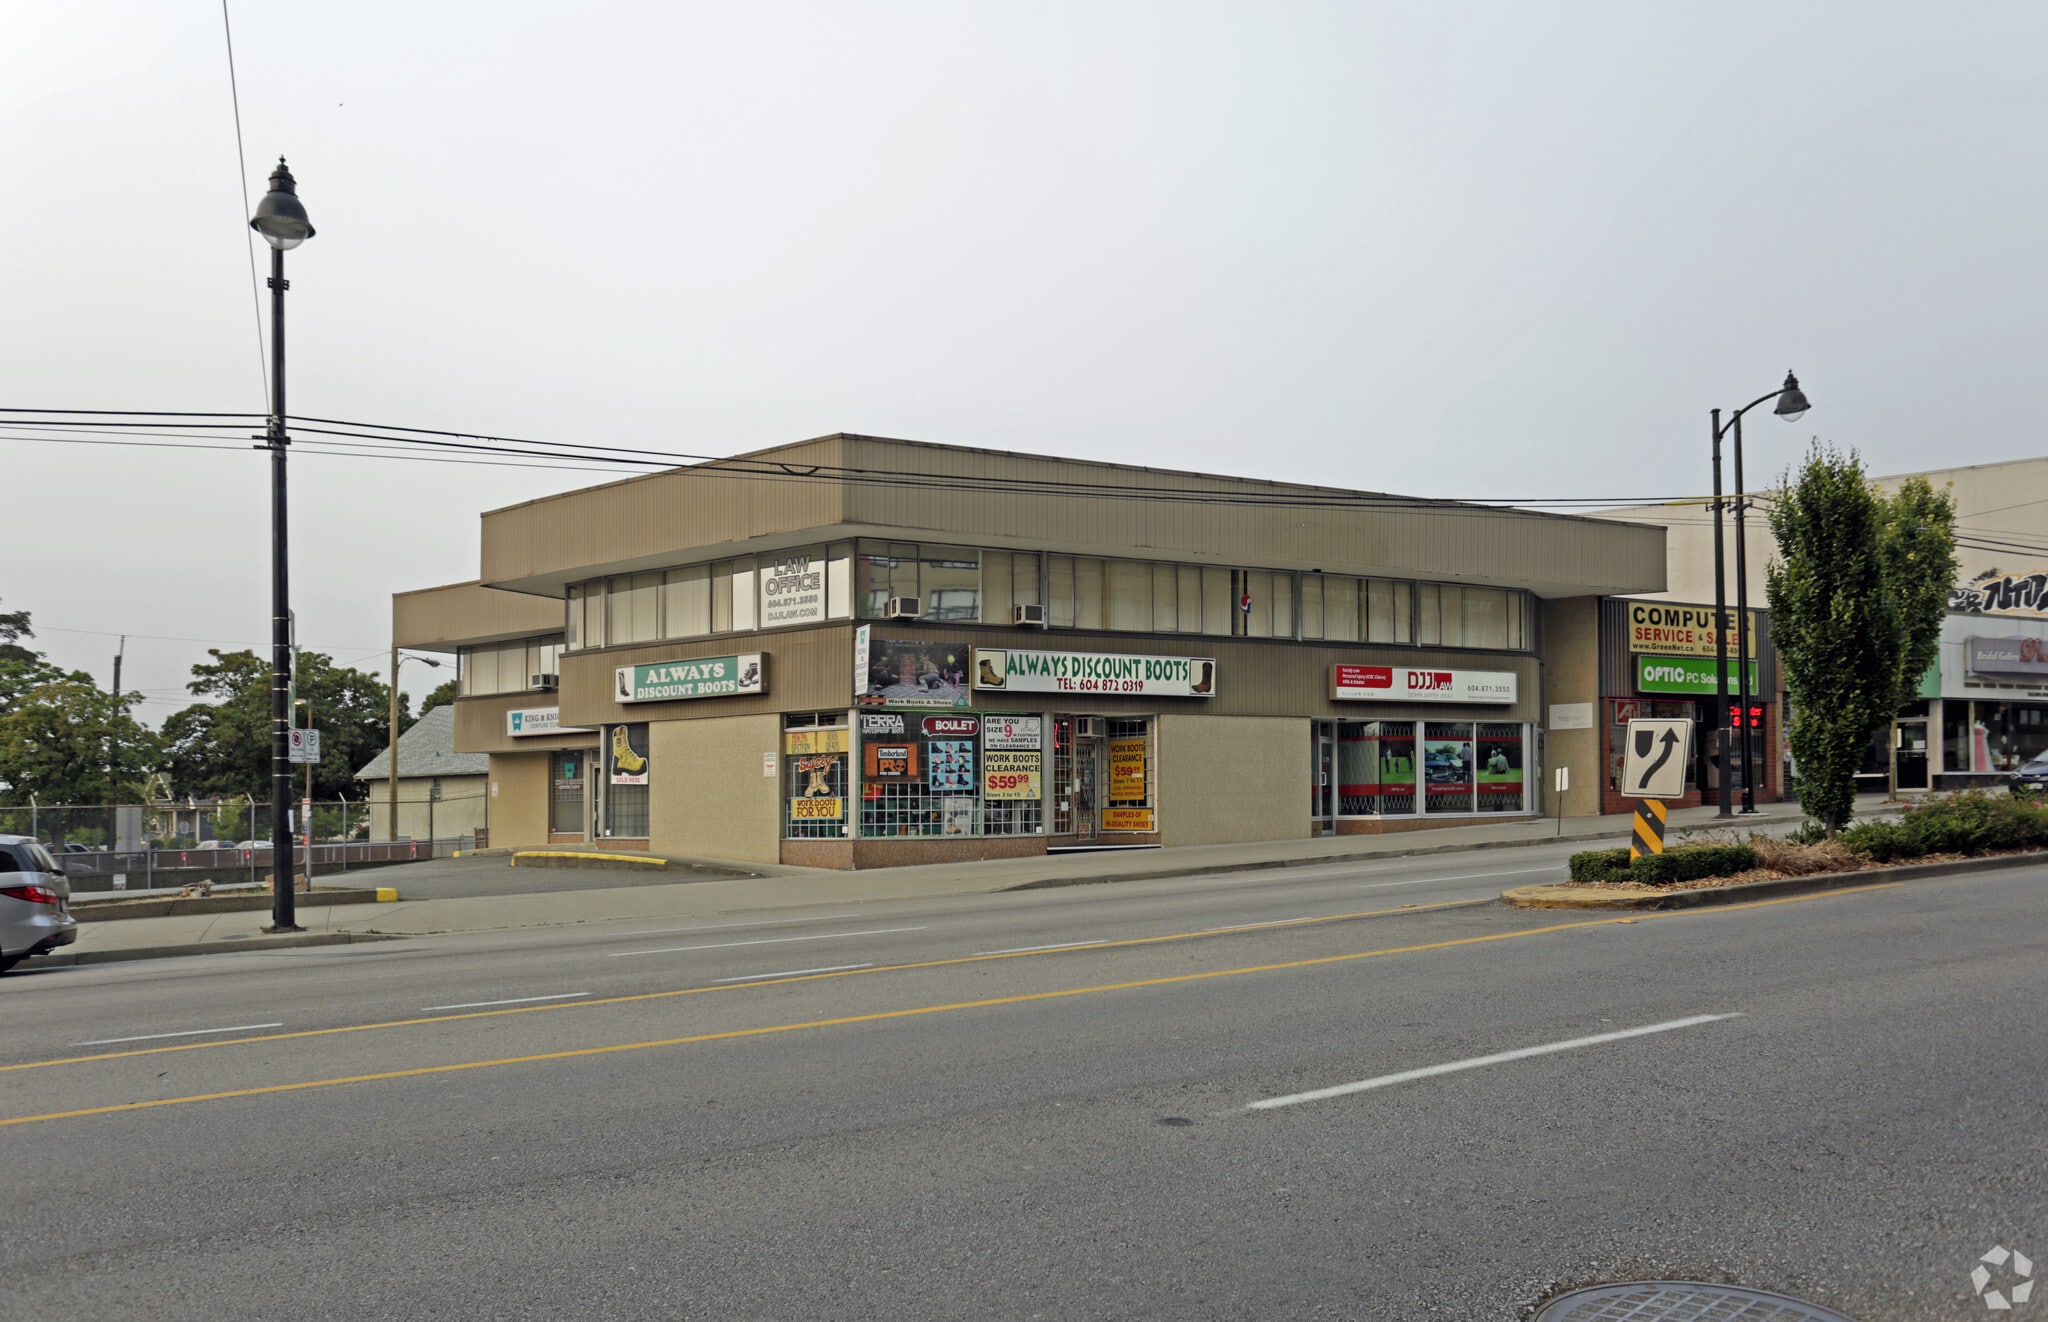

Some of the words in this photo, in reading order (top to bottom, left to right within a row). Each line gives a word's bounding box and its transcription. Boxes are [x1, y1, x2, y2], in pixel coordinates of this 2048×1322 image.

[774, 555, 811, 576] LAW
[765, 572, 820, 596] OFFICE
[1633, 606, 1750, 631] COMPUE
[1635, 627, 1693, 643] SERVICE
[1632, 643, 1694, 652] www.GreenNet.ca
[645, 662, 725, 684] ALWAYS
[1006, 653, 1068, 678] ALWAYS
[1071, 656, 1142, 680] DISCOUNT
[1145, 658, 1189, 681] BOOTS
[1407, 671, 1433, 690] DJJ
[1644, 665, 1685, 682] OPTIC
[1686, 672, 1699, 683] PC
[1701, 673, 1738, 685] Soluns
[637, 684, 694, 699] DISCOUNT
[697, 680, 736, 694] BOOTS
[1057, 678, 1077, 690] TEL:
[1079, 678, 1099, 691] 604
[1102, 679, 1119, 691] 872
[1122, 680, 1144, 693] 0319
[524, 714, 540, 722] KING
[860, 715, 904, 728] TERRA
[935, 720, 975, 731] BOULET
[1004, 724, 1013, 737] 9
[879, 749, 907, 757] Timberland
[1110, 745, 1126, 753] WORK
[1127, 744, 1145, 752] BOOTS
[798, 754, 839, 776] Safety
[985, 754, 1011, 763] WORK
[1012, 754, 1040, 763] BOOTS
[1112, 754, 1143, 763] CLEARANCE
[985, 764, 1040, 772] CLEARANCE
[796, 807, 814, 817] FOR
[816, 806, 836, 817] YOU
